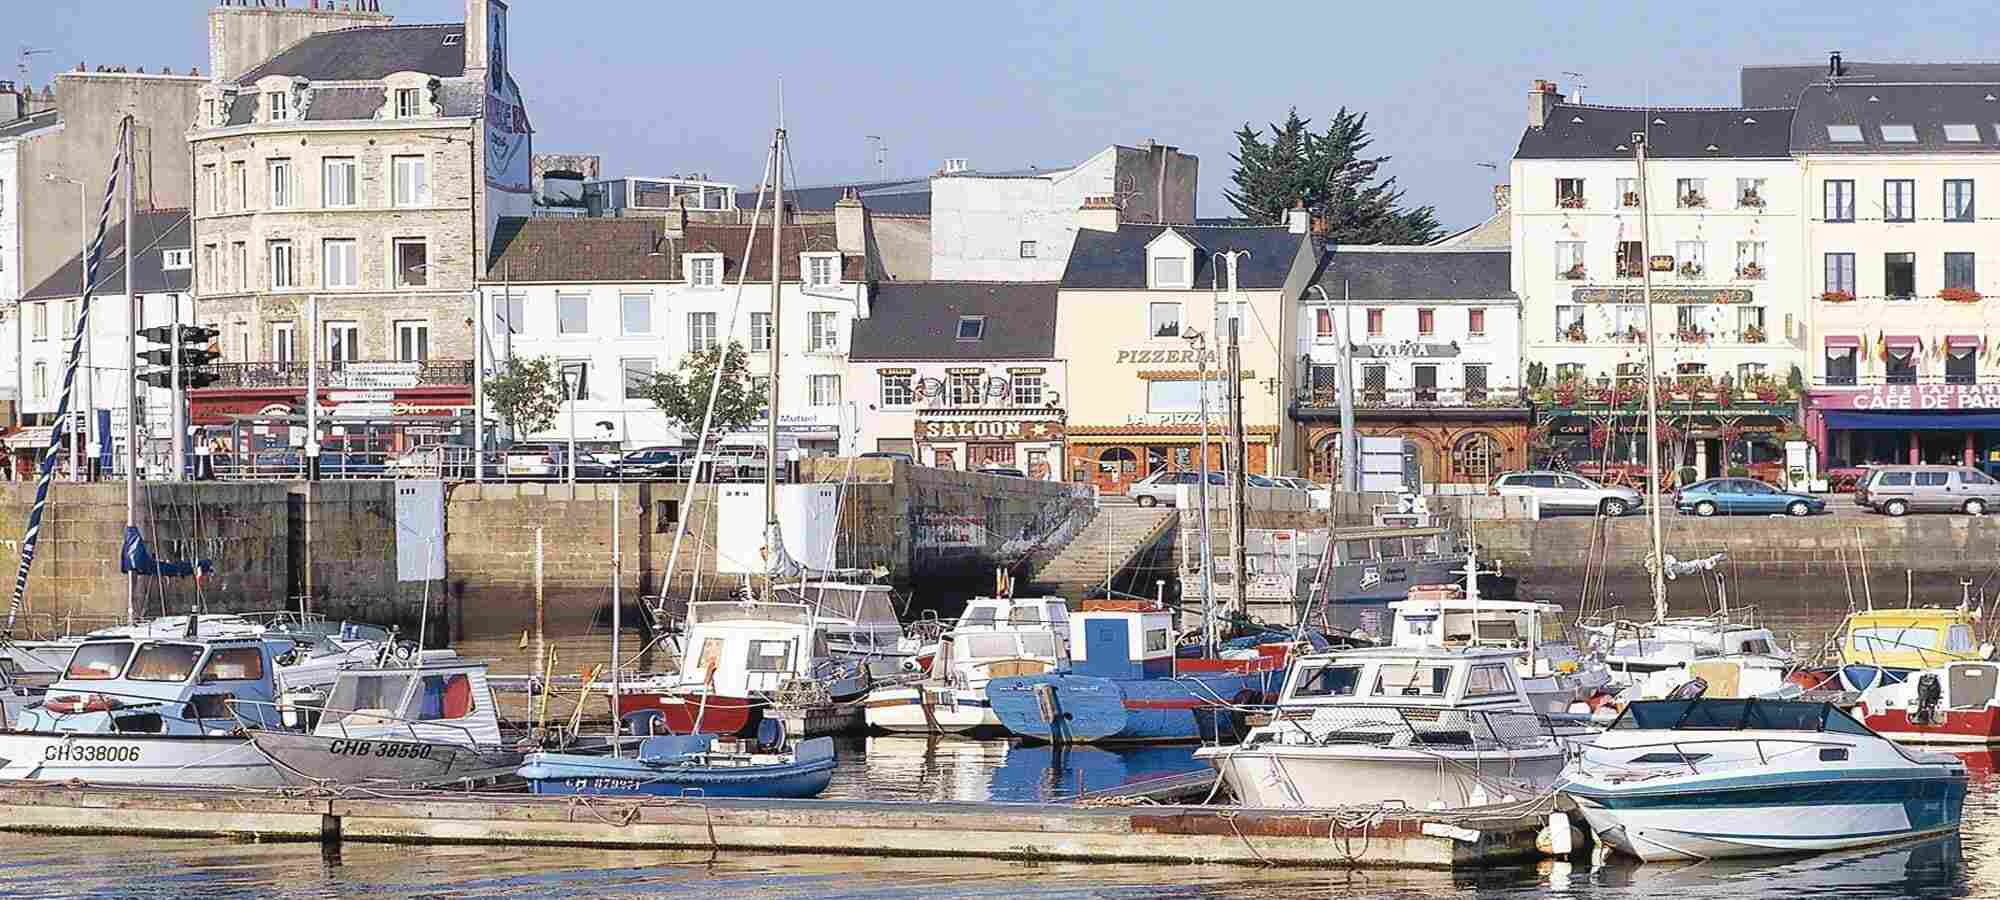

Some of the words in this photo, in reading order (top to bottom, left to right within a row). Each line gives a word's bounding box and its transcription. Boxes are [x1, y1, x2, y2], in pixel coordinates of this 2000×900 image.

[1116, 350, 1217, 364] PIZZERIA
[1920, 395, 1951, 410] DE
[926, 421, 1022, 438] SALOON
[330, 740, 371, 756] CHB
[375, 742, 432, 759] 38550
